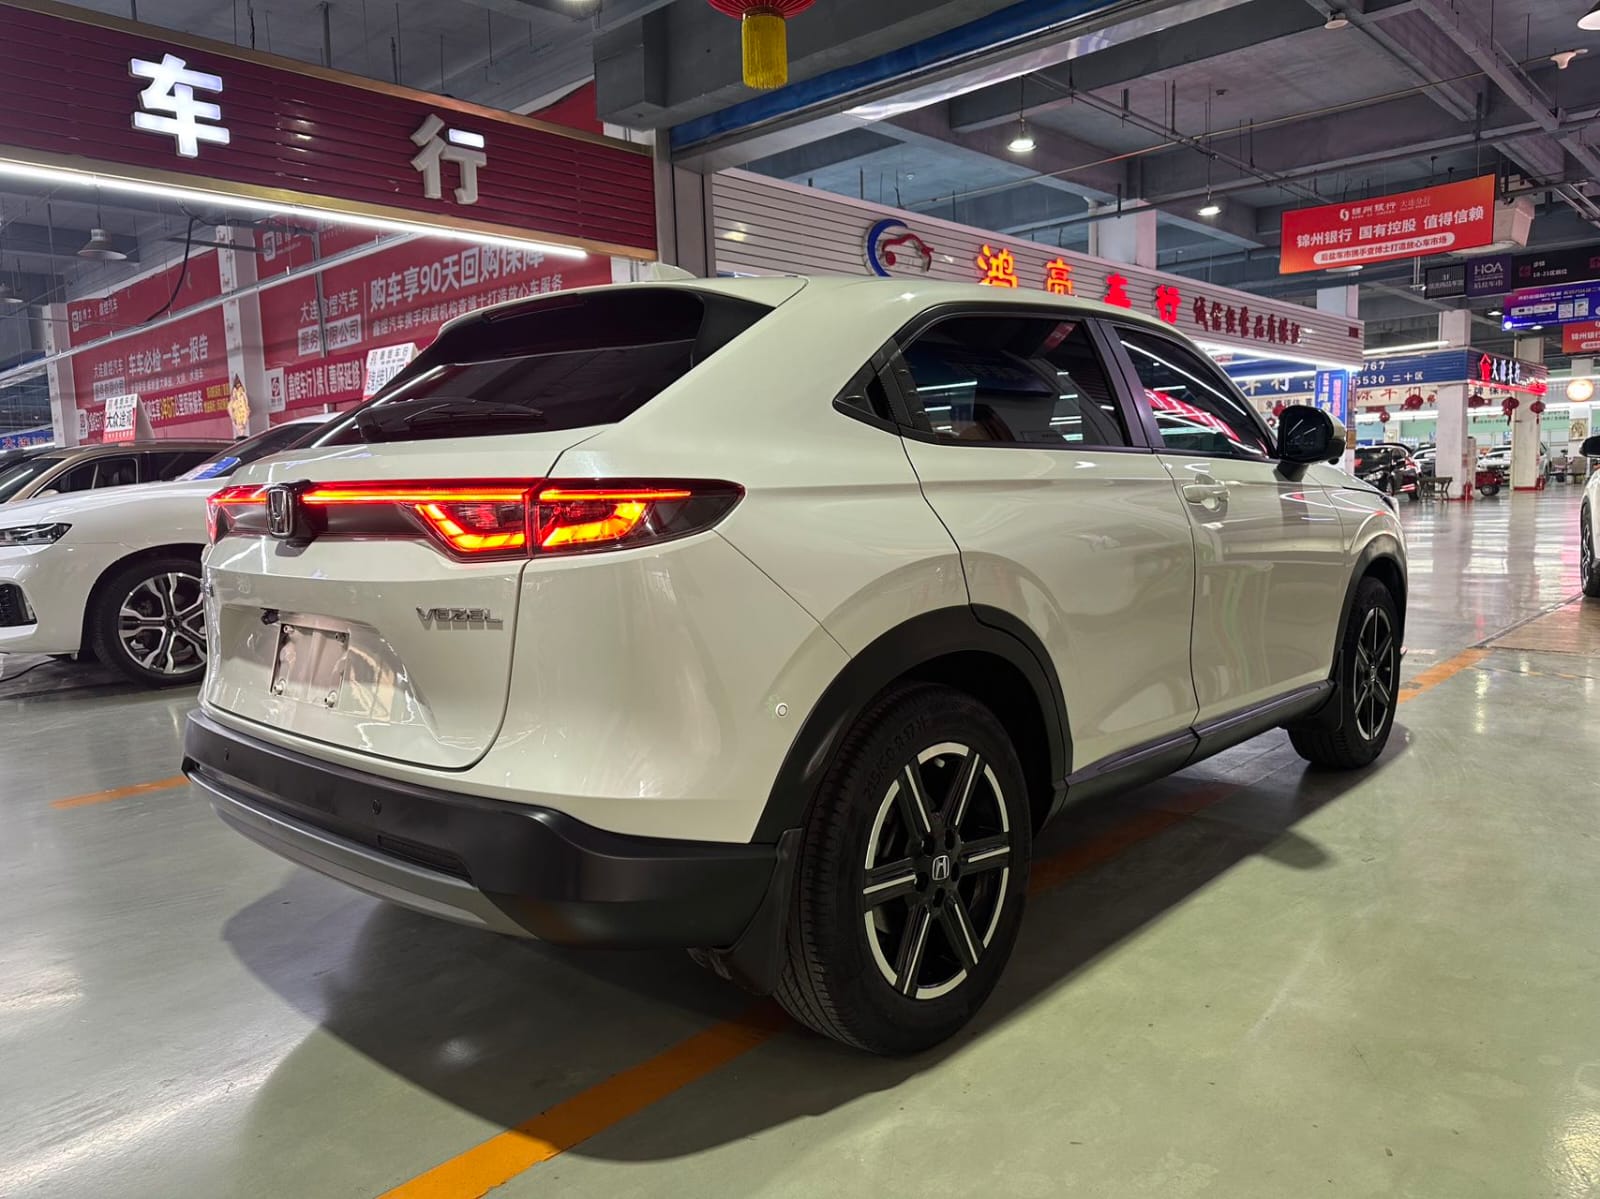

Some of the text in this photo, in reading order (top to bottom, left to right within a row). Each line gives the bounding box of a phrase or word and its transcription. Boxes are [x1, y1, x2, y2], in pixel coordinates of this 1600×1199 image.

[130, 53, 488, 205] 车行
[1296, 206, 1484, 248] 锦州银行 国有控股 值得信赖
[415, 607, 503, 623] VEZEL
